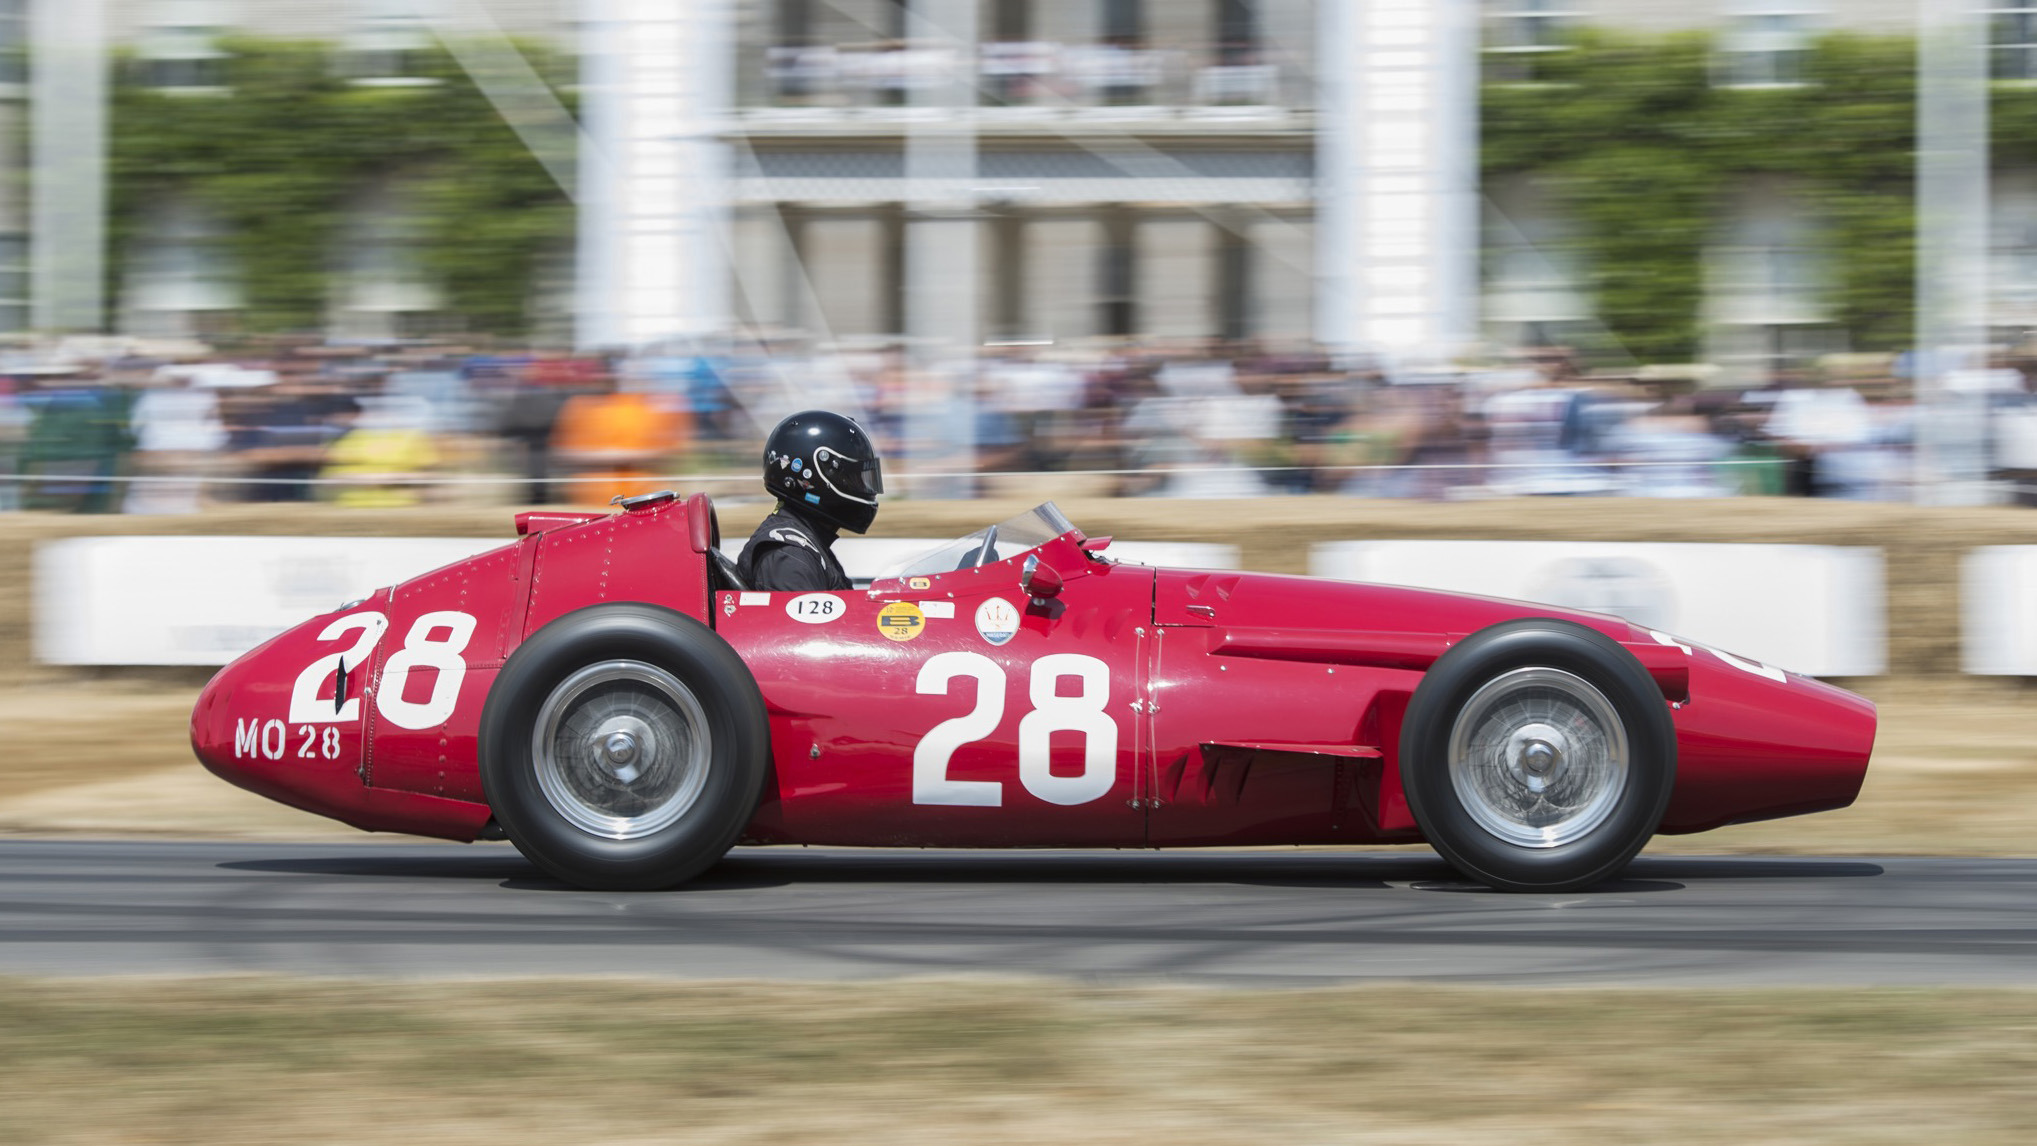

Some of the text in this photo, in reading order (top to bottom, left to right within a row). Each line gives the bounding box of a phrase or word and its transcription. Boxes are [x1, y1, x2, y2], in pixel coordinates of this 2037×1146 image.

[798, 601, 833, 615] 128
[289, 611, 477, 730] 28
[235, 718, 341, 760] MO 28
[912, 651, 1118, 807] 28
